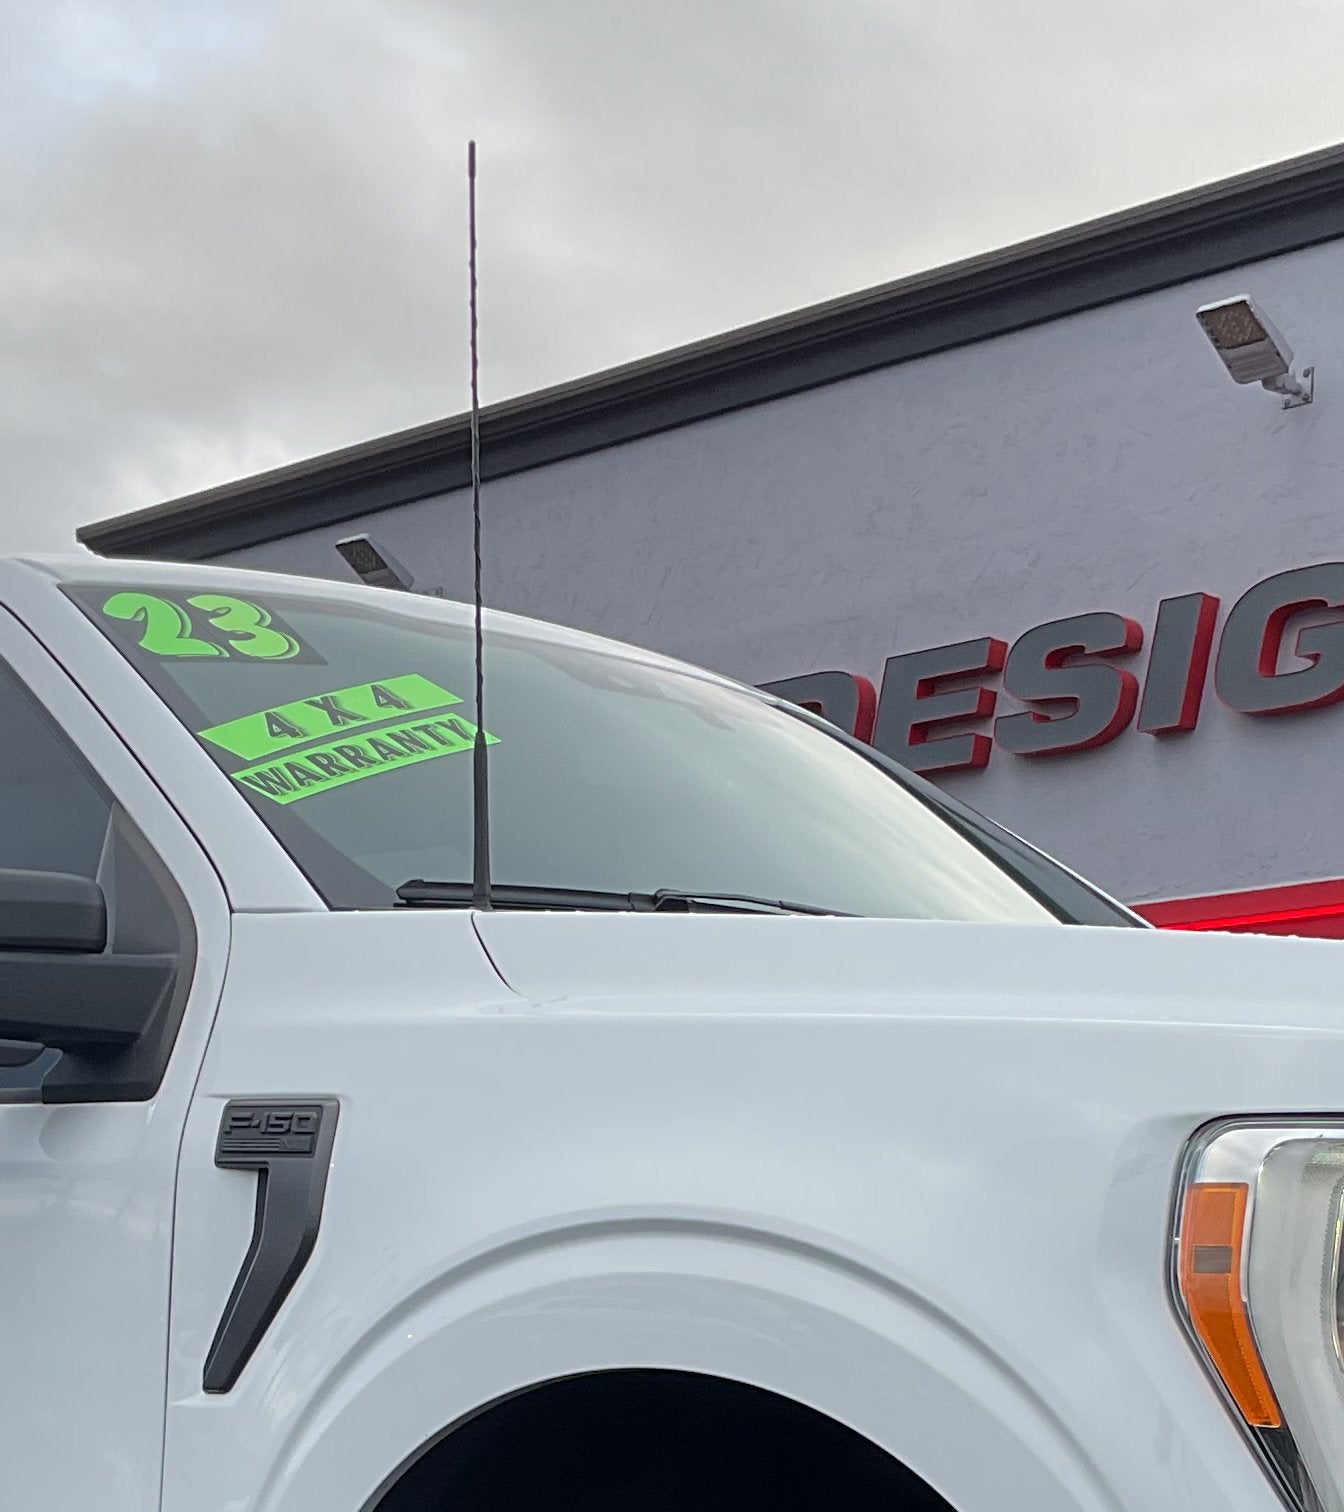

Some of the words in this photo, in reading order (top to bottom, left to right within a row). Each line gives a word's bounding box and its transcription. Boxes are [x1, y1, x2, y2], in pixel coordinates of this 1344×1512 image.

[102, 592, 301, 660] 23
[243, 718, 475, 798] WARRANTY
[223, 1111, 319, 1135] F-150
